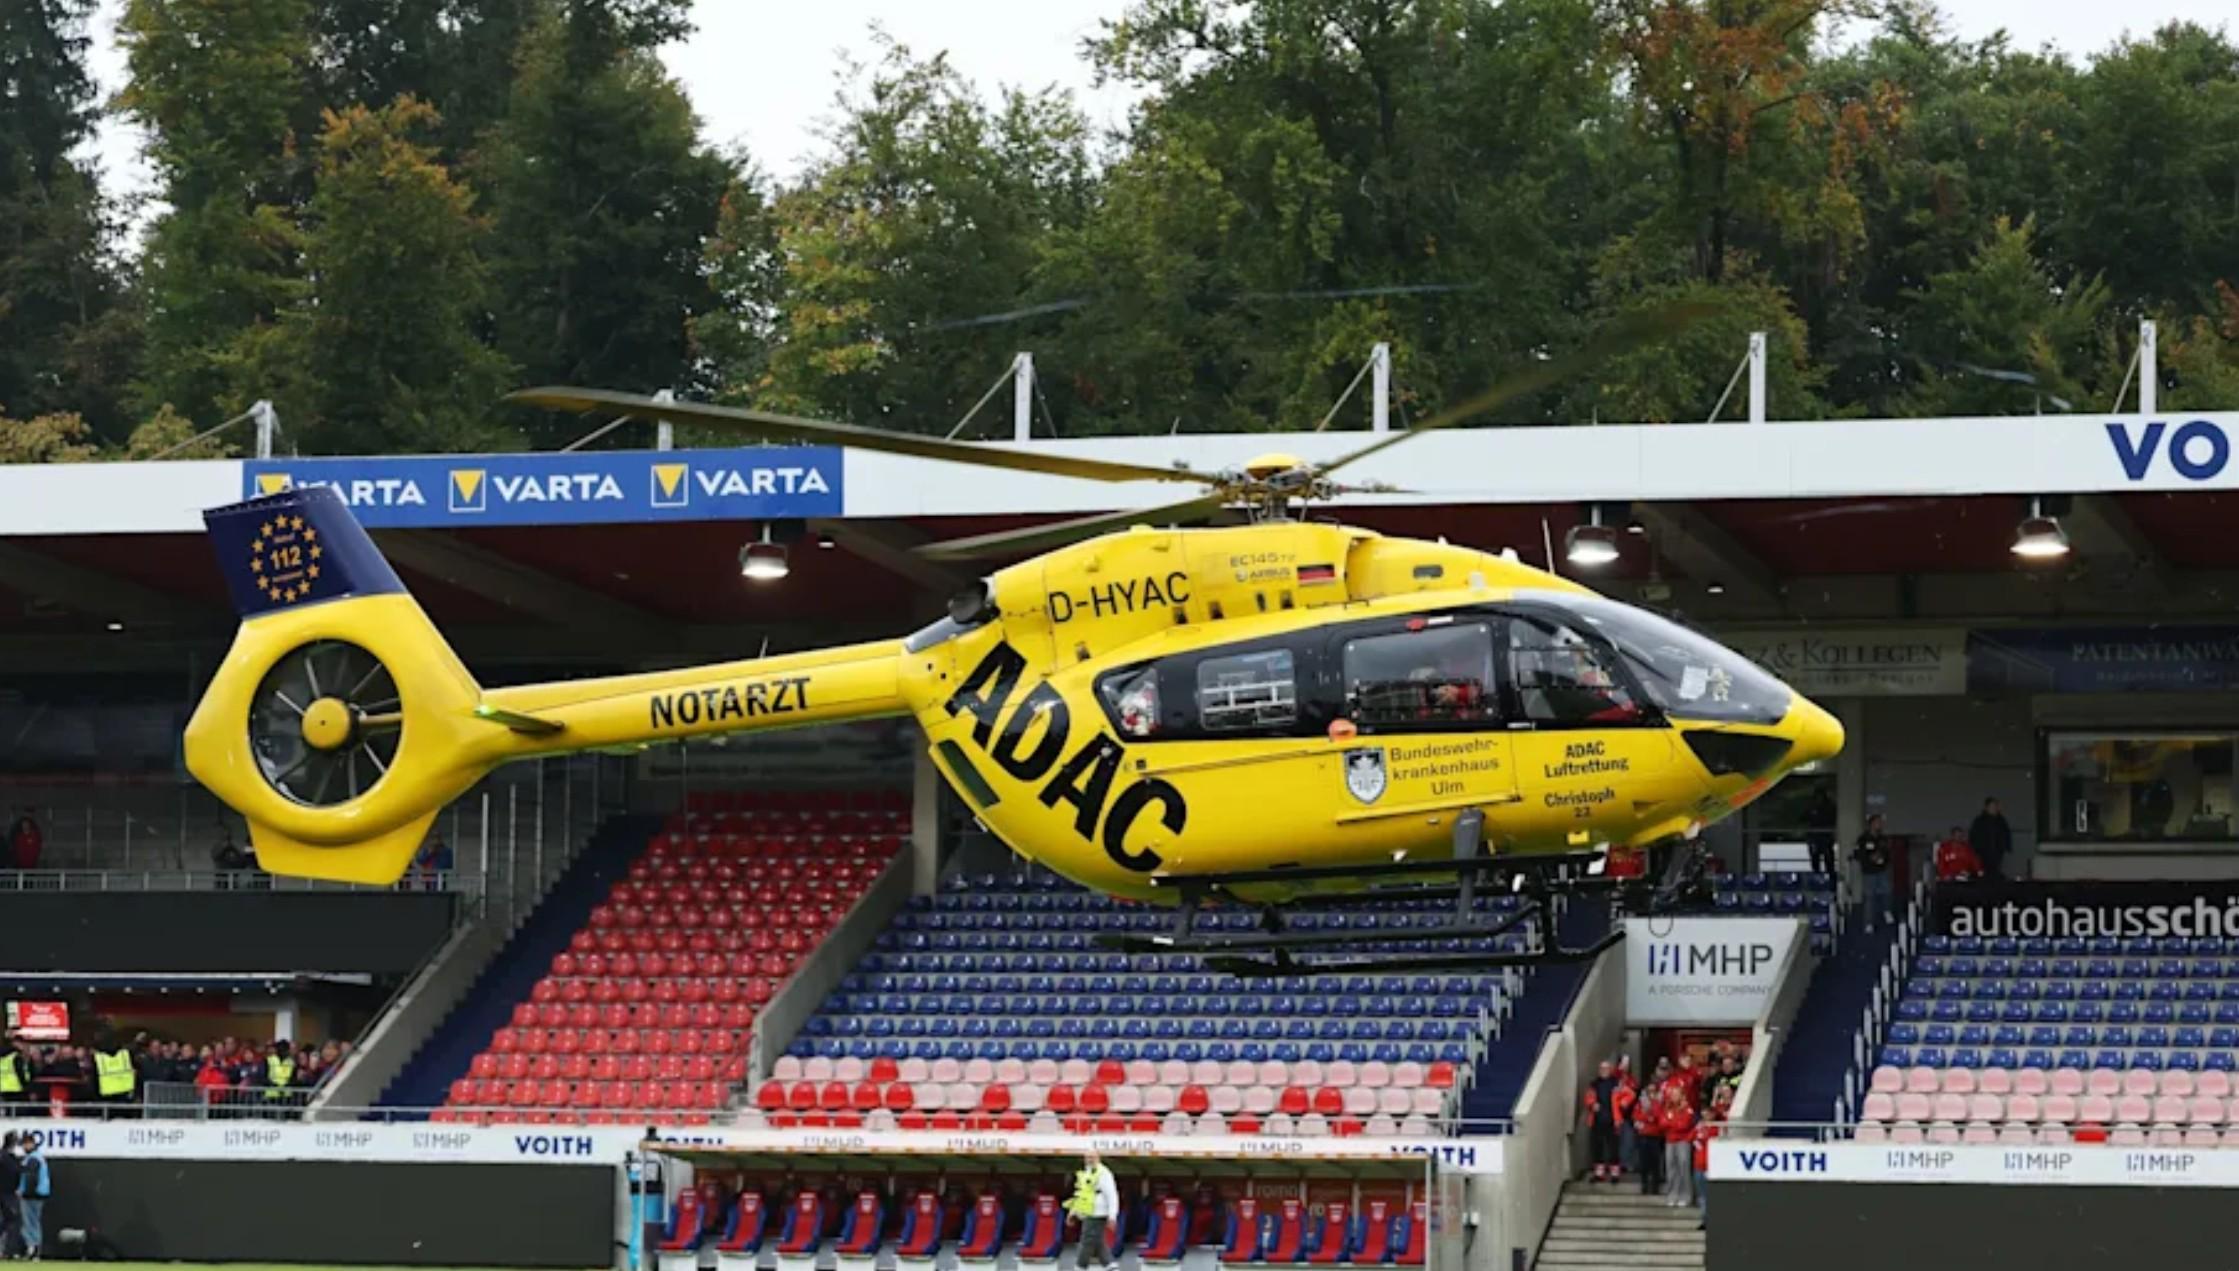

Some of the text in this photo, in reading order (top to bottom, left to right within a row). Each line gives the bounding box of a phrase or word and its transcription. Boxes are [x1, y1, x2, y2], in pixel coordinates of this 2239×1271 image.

[2105, 419, 2231, 482] VO
[493, 474, 625, 503] VARTA
[696, 466, 830, 497] VARTA
[270, 546, 303, 570] 112
[1048, 571, 1191, 624] D-HYAC
[650, 675, 811, 729] NOTARZT
[944, 640, 1188, 873] ADAC
[1390, 738, 1499, 762] Bundeswehr-
[1565, 740, 1606, 758] ADAC
[1392, 758, 1500, 781] krankenhaus
[1543, 757, 1630, 778] Luftrettung
[1430, 780, 1464, 796] Ulm
[1543, 786, 1616, 808] Christoph
[1688, 943, 1774, 976] MHP
[1660, 984, 1714, 996] PORSCHE
[148, 1128, 185, 1146] MHP
[241, 1129, 281, 1147] MHP
[333, 1131, 373, 1148] MHP
[431, 1132, 472, 1150] MHP
[514, 1135, 593, 1155] VOITH
[1738, 1150, 1827, 1172] VOITH
[1908, 1152, 1954, 1169] MHP
[2026, 1153, 2073, 1170] MHP
[2149, 1154, 2195, 1172] MHP
